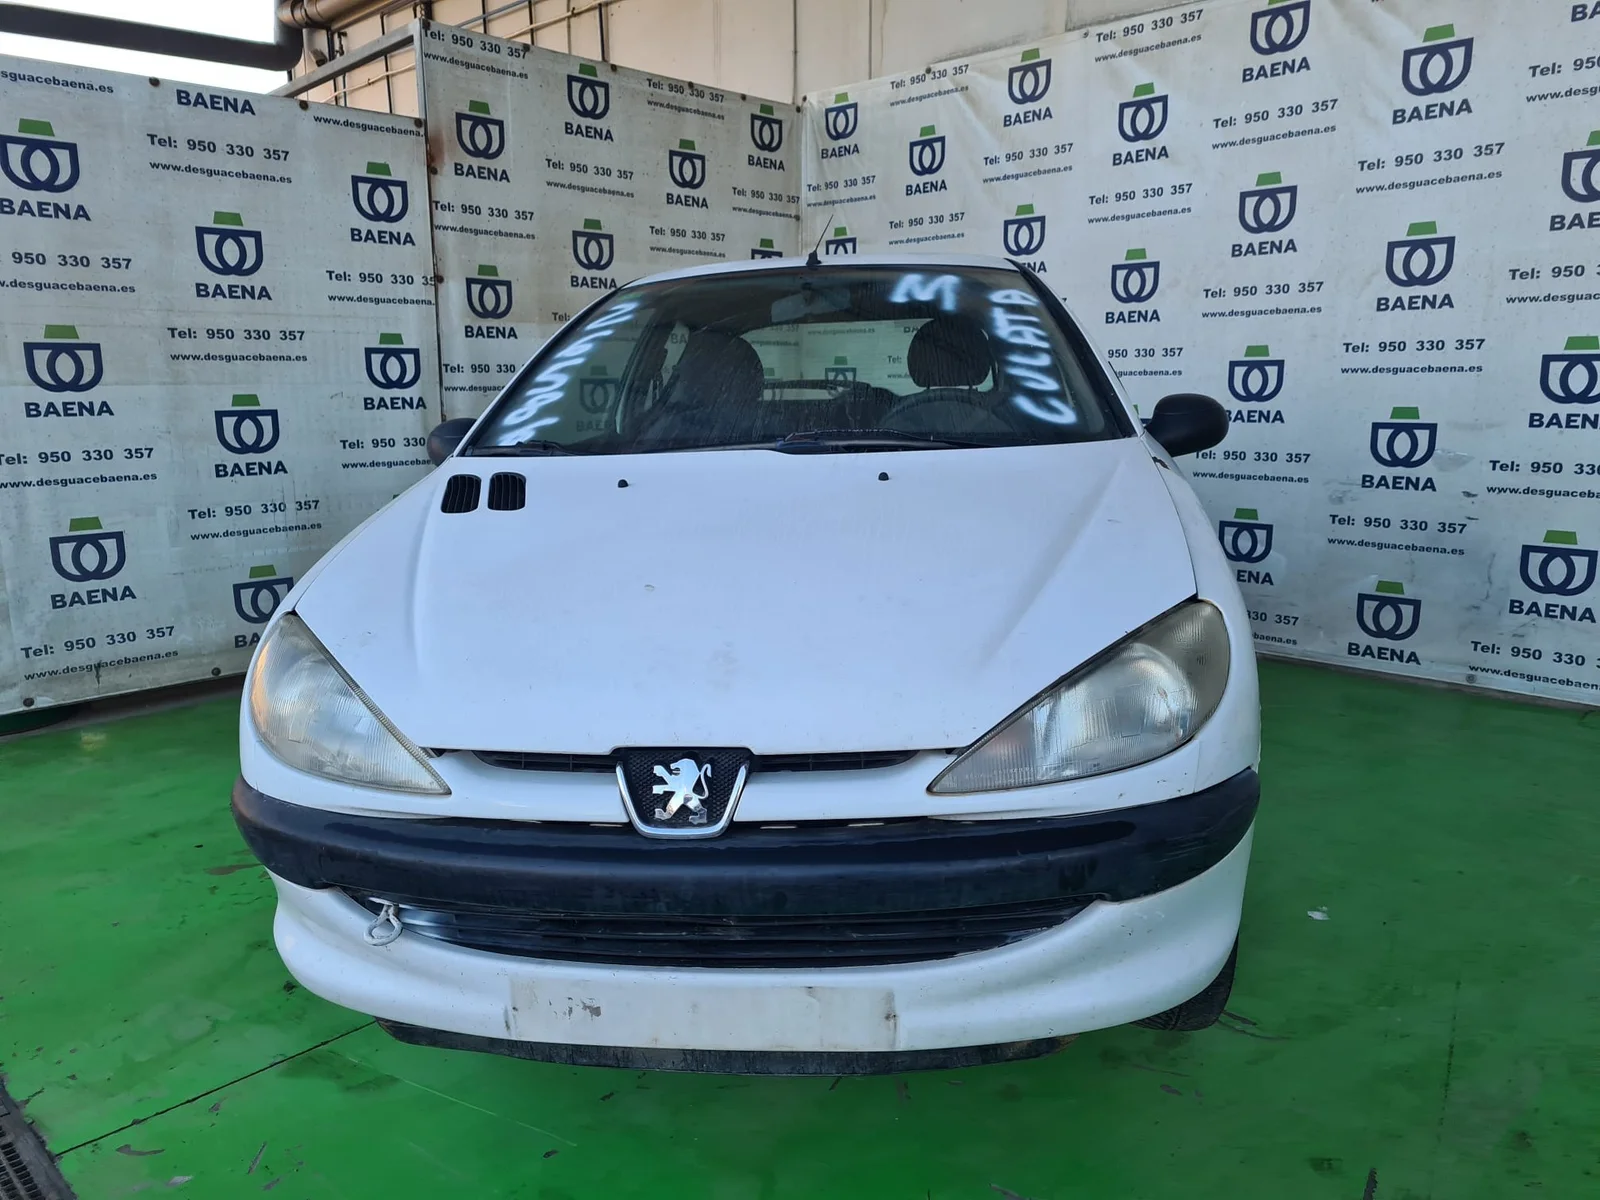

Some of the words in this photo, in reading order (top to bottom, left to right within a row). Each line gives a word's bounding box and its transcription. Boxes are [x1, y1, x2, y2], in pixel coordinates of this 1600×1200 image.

[1096, 30, 1116, 43] Tel:
[1123, 23, 1144, 37] 950
[1151, 16, 1173, 30] 330
[1180, 9, 1203, 24] 357
[424, 28, 445, 42] Tel:
[452, 34, 473, 48] 950
[480, 40, 500, 54] 330
[507, 46, 528, 59] 357
[1095, 35, 1202, 63] www.desguacebaena.es
[424, 52, 529, 80] www.desguacebaena.es
[1242, 56, 1310, 83] BAENA
[1528, 62, 1562, 78] Tel:
[1, 71, 114, 93] sguacebaena.es
[890, 79, 906, 90] Tel:
[910, 74, 926, 85] 950
[931, 69, 947, 80] 330
[952, 64, 969, 76] 357
[646, 78, 664, 90] Tel:
[668, 83, 684, 94] 950
[690, 88, 705, 99] 330
[709, 92, 724, 103] 357
[176, 89, 256, 116] BAENA
[1392, 98, 1472, 125] BAENA
[313, 115, 426, 137] www.desguacebaena.
[1003, 106, 1053, 128] BAENA
[565, 122, 614, 142] BAENA
[146, 133, 178, 148] Tel:
[187, 139, 216, 153] 950
[226, 144, 254, 158] 330
[263, 148, 289, 161] 357
[821, 144, 859, 159] BAENA
[984, 155, 1000, 166] Tel:
[1005, 151, 1023, 162] 950
[1029, 147, 1048, 158] 330
[1054, 143, 1073, 155] 357
[1112, 146, 1169, 166] BAENA
[748, 154, 785, 172] BAENA
[1358, 158, 1385, 171] Tel:
[1395, 153, 1424, 167] 950
[1433, 148, 1463, 162] 330
[1473, 142, 1505, 157] 357
[149, 162, 292, 183] www.desguacebaena.es
[454, 162, 510, 183] BAENA
[545, 158, 564, 170] Tel:
[570, 162, 588, 174] 950
[594, 166, 612, 177] 330
[617, 169, 634, 180] 357
[983, 165, 1072, 184] www.desguacebaena.es
[906, 179, 947, 196] BAENA
[1356, 171, 1502, 194] www.desguacebaena.es
[0, 198, 92, 221] BAENA
[666, 192, 708, 209] BAENA
[433, 200, 454, 212] Tel:
[461, 204, 481, 216] 950
[488, 207, 508, 218] 330
[514, 210, 534, 221] 357
[1088, 207, 1191, 224] www.desguacebaena.es
[889, 220, 904, 229] Tel:
[908, 217, 924, 227] 950
[928, 214, 944, 224] 330
[949, 212, 965, 222] 357
[350, 228, 416, 246] BAENA
[434, 224, 535, 240] www.desguacebaena.es
[649, 226, 665, 236] Tel:
[670, 228, 686, 238] 950
[691, 230, 706, 240] 330
[711, 232, 725, 242] 357
[1231, 238, 1297, 258] BAENA
[12, 252, 46, 265] 950
[57, 254, 90, 268] 330
[100, 257, 132, 270] 357
[326, 270, 351, 282] Tel:
[359, 272, 383, 284] 950
[391, 274, 414, 285] 330
[422, 276, 436, 286] 35
[1509, 268, 1540, 280] Tel:
[1552, 265, 1585, 278] 950
[195, 282, 272, 300] BAENA
[570, 275, 617, 289] BAENA
[328, 295, 435, 306] www.desguacebaena.
[1376, 294, 1454, 312] BAENA
[552, 312, 570, 321] Tel:
[1105, 309, 1160, 324] BAENA
[464, 325, 518, 339] BAENA
[1108, 349, 1128, 358] 950
[1134, 348, 1155, 358] 330
[1162, 347, 1183, 357] 357
[1343, 342, 1369, 353] Tel:
[1378, 341, 1406, 352] 950
[1416, 340, 1445, 351] 330
[1454, 338, 1486, 350] 357
[443, 364, 464, 373] Tel:
[470, 364, 490, 374] 950
[496, 364, 516, 374] 330
[1341, 364, 1482, 375] www.desguacebaena.es
[24, 401, 114, 418] BAENA
[364, 396, 427, 410] BAENA
[1528, 413, 1600, 430] BAEN
[340, 439, 364, 449] Tel:
[372, 438, 396, 448] 950
[403, 437, 426, 447] 330
[0, 453, 28, 466] Tel:
[38, 451, 71, 463] 950
[82, 449, 114, 461] 330
[124, 448, 154, 459] 357
[1195, 450, 1216, 459] Tel:
[1223, 450, 1246, 461] 950
[1254, 452, 1278, 462] 330
[1286, 453, 1311, 464] 357
[214, 460, 288, 478] BAENA
[1489, 460, 1520, 472] Tel:
[1531, 462, 1563, 474] 950
[0, 474, 157, 489] www.desguacebaena.es
[1192, 472, 1309, 483] www.desguacebaena.es
[1361, 474, 1436, 492] BAENA
[188, 508, 216, 520] Tel:
[225, 505, 252, 517] 950
[260, 502, 286, 514] 330
[295, 500, 320, 511] 357
[190, 523, 322, 540] www.desguacebaena.es
[1329, 514, 1355, 526] Tel:
[1364, 517, 1391, 528] 950
[1400, 519, 1428, 531] 330
[1437, 522, 1467, 534] 357
[1328, 538, 1464, 555] www.desguacebaena.es
[1236, 570, 1274, 586] ENA
[50, 586, 137, 610] BAENA
[1274, 614, 1299, 626] 357
[1509, 599, 1596, 623] BAENA
[20, 644, 54, 659] Tel:
[64, 637, 96, 651] 950
[106, 632, 136, 645] 330
[146, 626, 174, 639] 357
[1348, 642, 1421, 665] BAENA
[1471, 641, 1500, 654] Tel:
[1511, 646, 1542, 660] 950
[1552, 652, 1585, 666] 330
